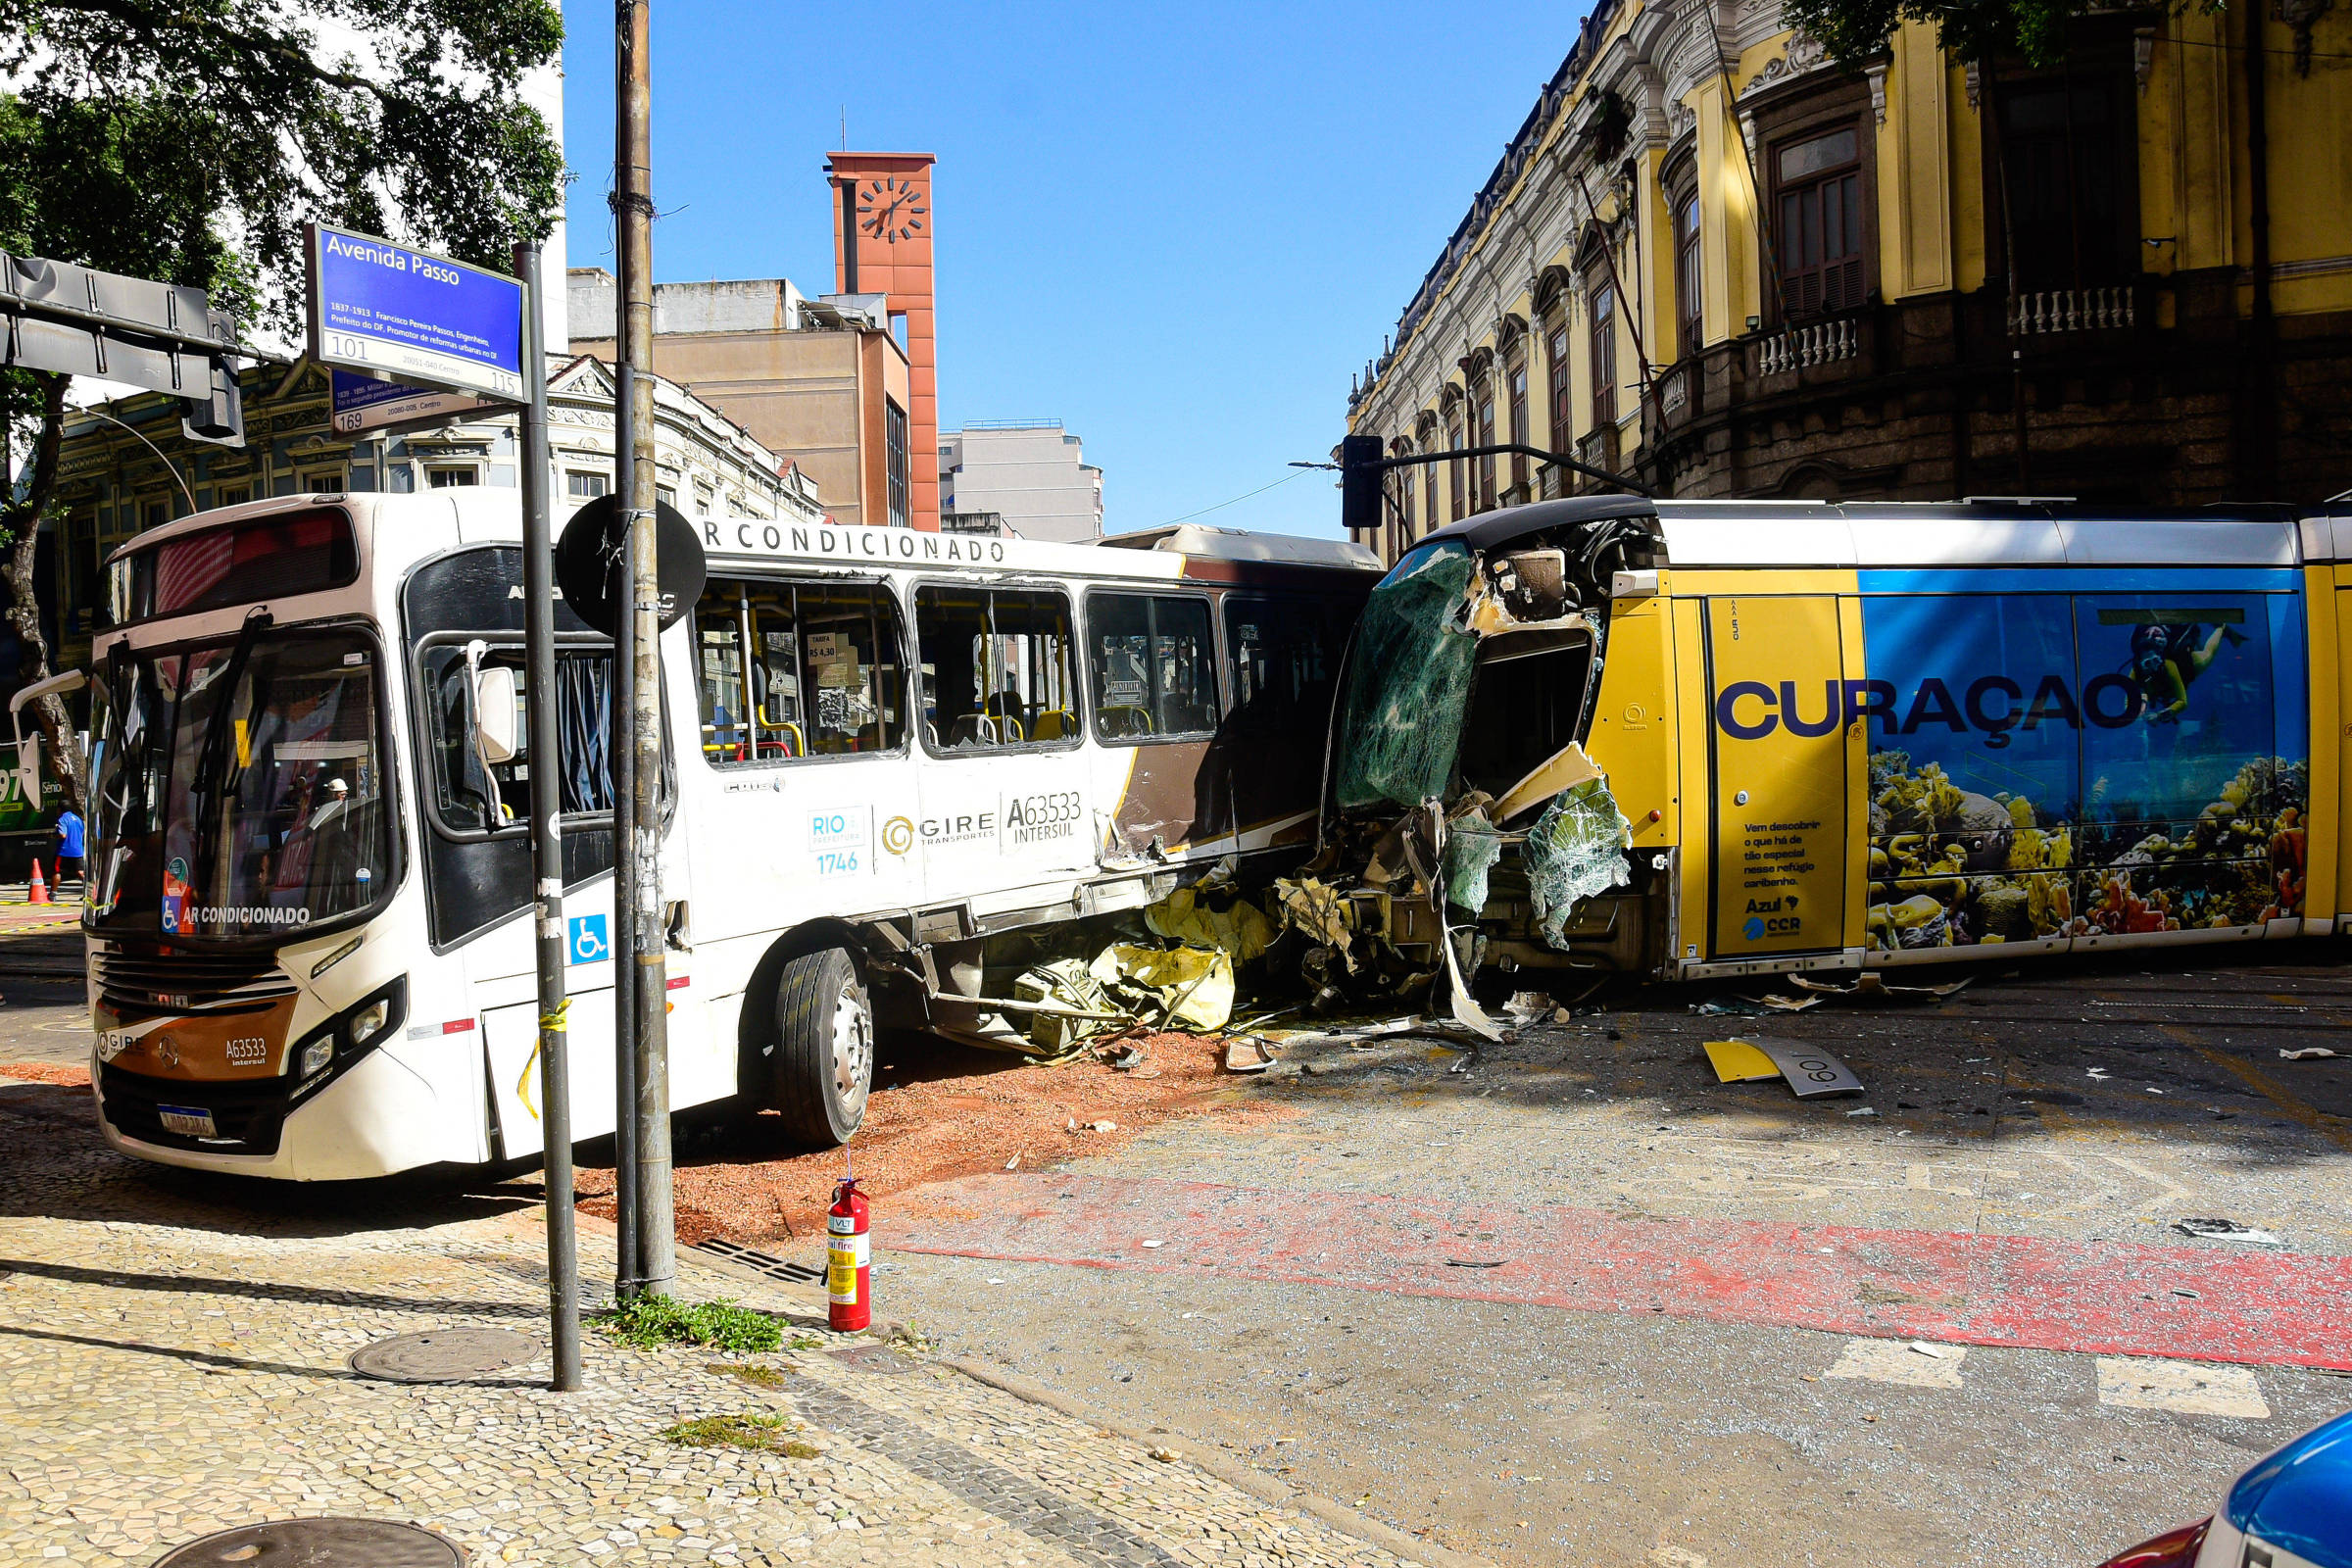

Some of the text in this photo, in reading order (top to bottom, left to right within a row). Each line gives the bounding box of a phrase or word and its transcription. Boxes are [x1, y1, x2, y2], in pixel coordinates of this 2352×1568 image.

[326, 235, 460, 286] Avenida Passo
[330, 302, 371, 318] 1837-1913
[376, 311, 409, 326] Francisco
[409, 318, 432, 332] Pereira
[331, 314, 361, 326] Prefeito
[362, 320, 372, 329] do
[386, 325, 419, 339] Promotor
[419, 333, 429, 343] de
[429, 336, 458, 350] reformas
[458, 343, 481, 356] urbanas
[332, 336, 368, 360] 101
[439, 363, 461, 375] Centro
[492, 371, 515, 394] 115
[419, 400, 441, 410] Centro
[339, 413, 363, 431] 169
[704, 520, 1004, 562] R CONDICIONADO
[1716, 673, 2143, 749] CURAÇAO
[1006, 791, 1081, 828] A63533
[812, 814, 845, 835] RIO
[919, 812, 995, 837] GIRE
[1014, 822, 1073, 844] INTERSUL
[1744, 820, 1821, 833] Vem descobrir
[921, 830, 995, 846] TRANSPORTES
[1753, 838, 1773, 848] que
[1788, 835, 1802, 845] de
[817, 851, 858, 874] 1746
[1744, 849, 1805, 860] tão especial
[1777, 861, 1815, 873] refúgio
[182, 906, 311, 924] AR CONDICIONADO
[1745, 898, 1782, 913] Azul
[1767, 917, 1800, 932] CCR
[109, 1035, 145, 1052] GIRE
[226, 1037, 267, 1058] A63533
[837, 1240, 853, 1250] fire
